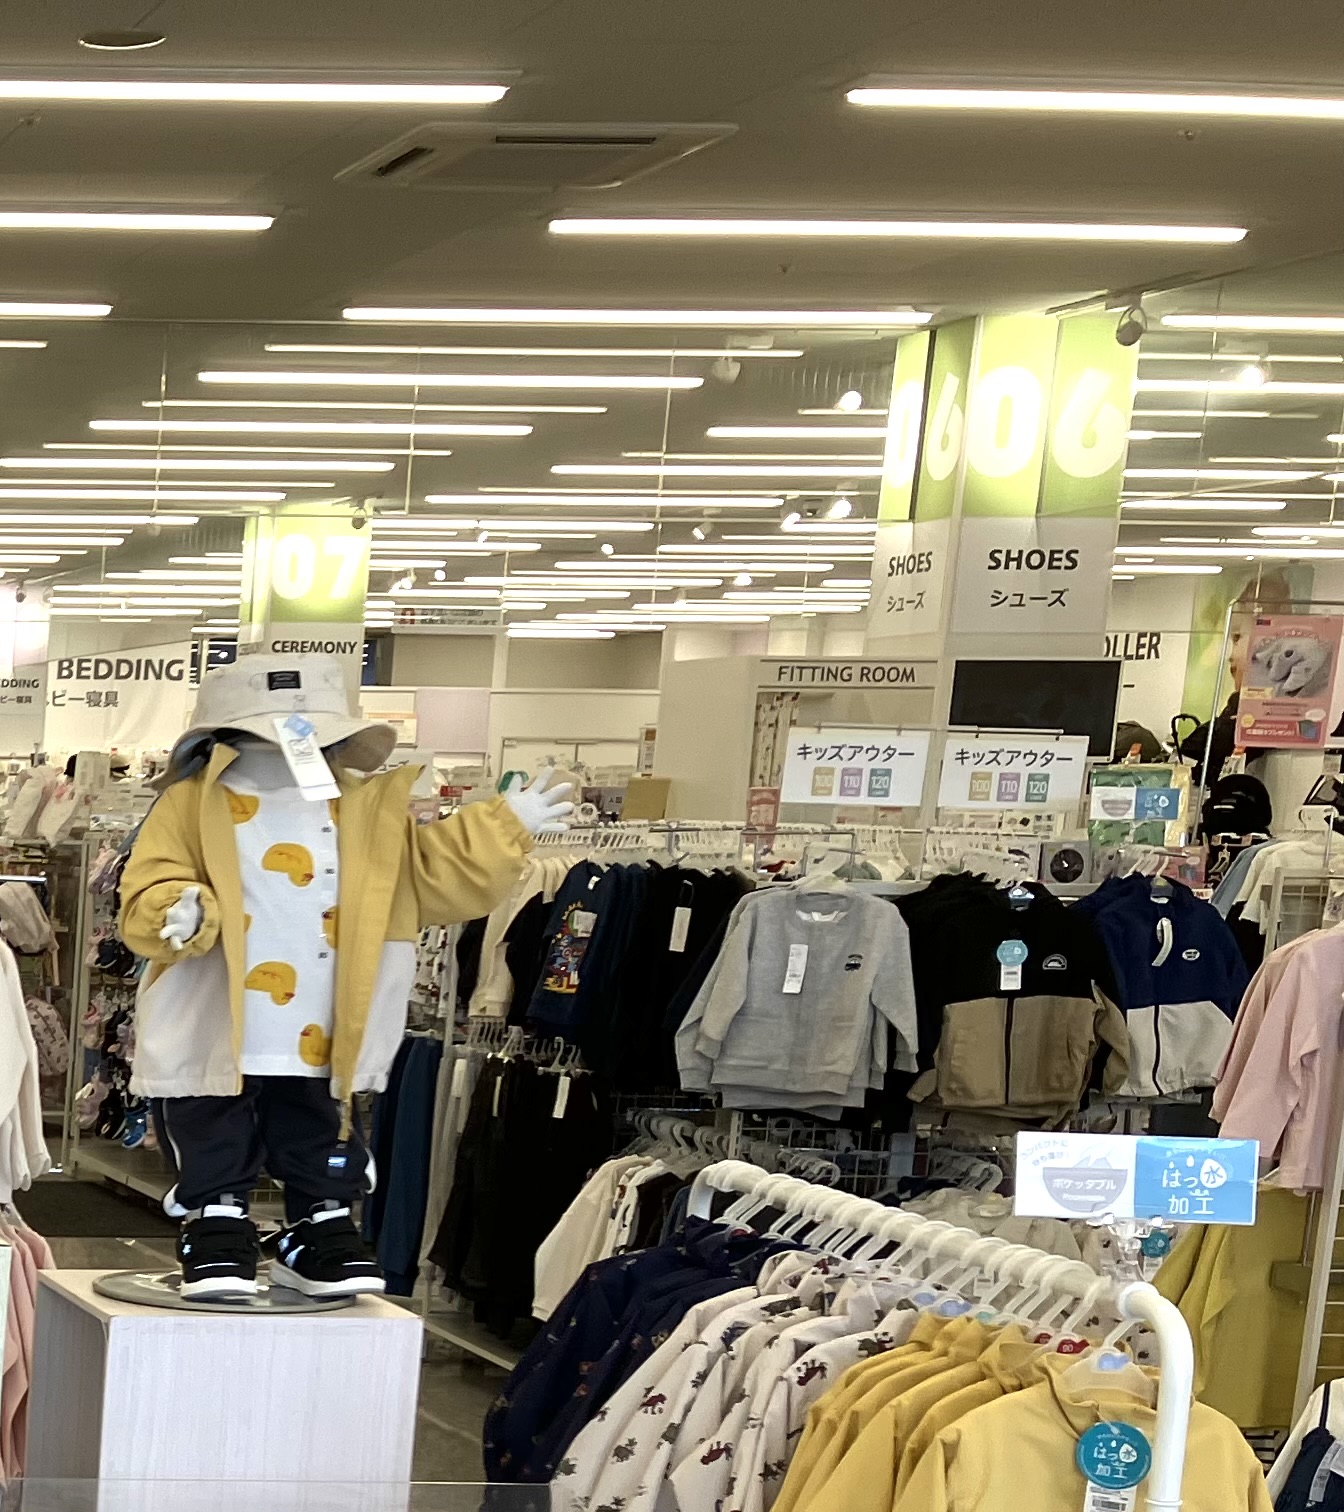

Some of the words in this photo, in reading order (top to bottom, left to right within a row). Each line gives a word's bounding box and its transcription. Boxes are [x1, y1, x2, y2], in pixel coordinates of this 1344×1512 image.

[967, 365, 1127, 478] 06
[272, 534, 369, 600] 07
[888, 551, 932, 577] SHOES
[987, 549, 1079, 571] SHOES
[887, 591, 925, 612] シューズ
[990, 589, 1069, 608] シューズ
[272, 640, 358, 654] CEREMONY
[57, 658, 184, 680] BEDDING
[778, 666, 853, 682] FITTING
[861, 666, 915, 683] ROOM
[797, 744, 915, 762] キッズアウター
[954, 749, 1073, 767] キッズアウター
[871, 775, 890, 789] 120
[1029, 780, 1047, 794] 120
[1052, 1178, 1116, 1191] ポケッタブル
[1163, 1164, 1224, 1189] はっ水
[1168, 1195, 1214, 1215] 加工
[1096, 1464, 1128, 1479] 加工
